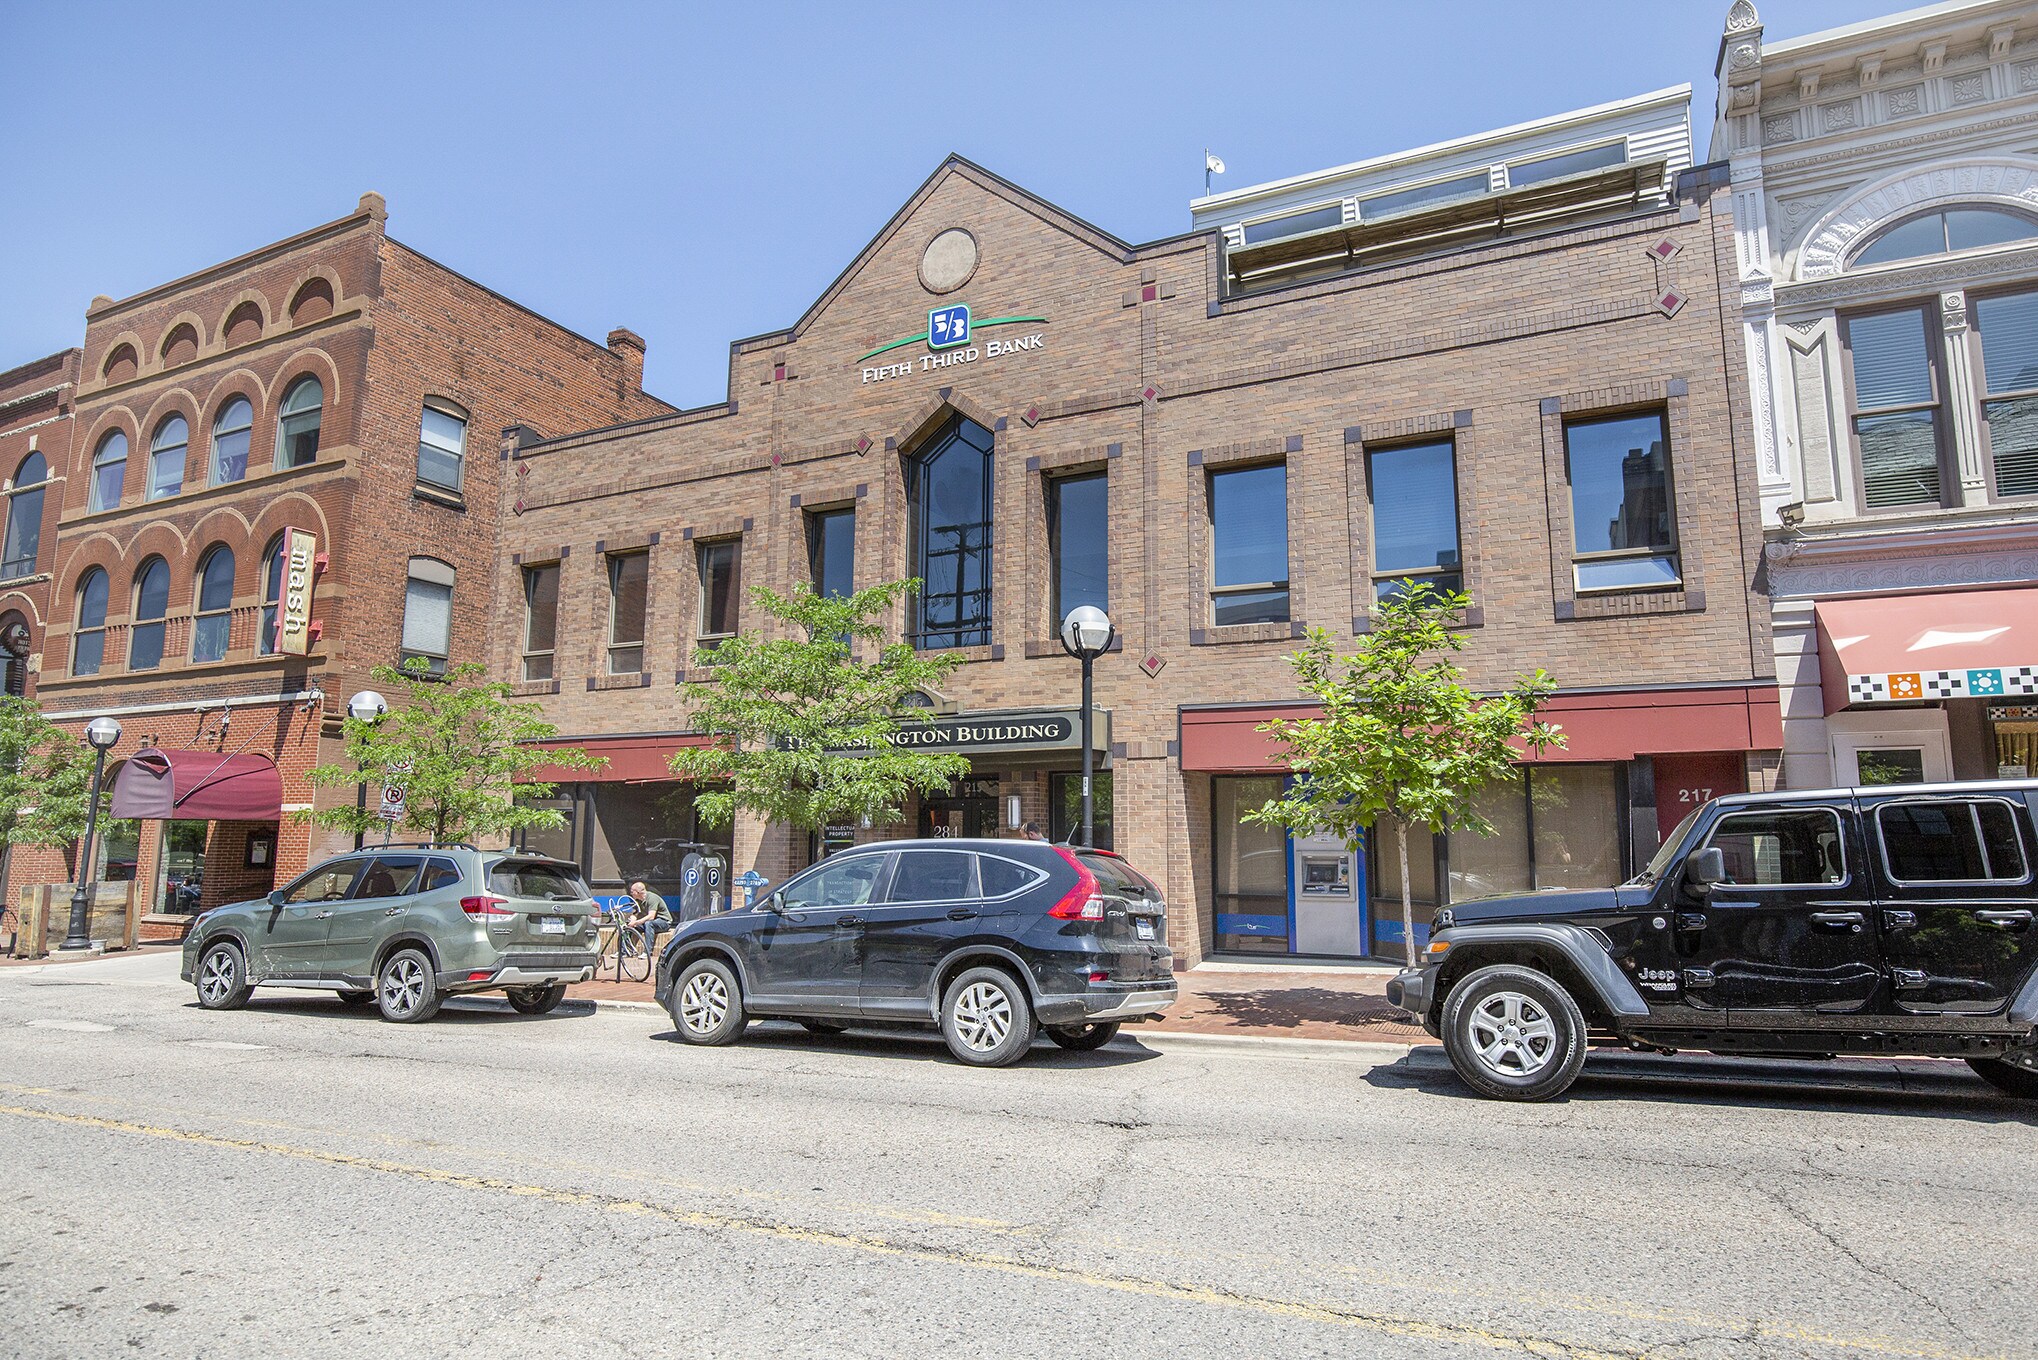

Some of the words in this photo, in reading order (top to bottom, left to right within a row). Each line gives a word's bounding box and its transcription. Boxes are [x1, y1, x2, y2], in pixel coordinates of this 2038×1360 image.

[862, 361, 912, 384] FIFTH
[919, 347, 979, 372] THIRD
[985, 333, 1044, 358] BANK
[285, 547, 307, 636] mash
[956, 723, 1060, 742] BUILDING
[1679, 789, 1712, 801] 217
[934, 826, 958, 838] 284
[1638, 967, 1676, 982] Jeep
